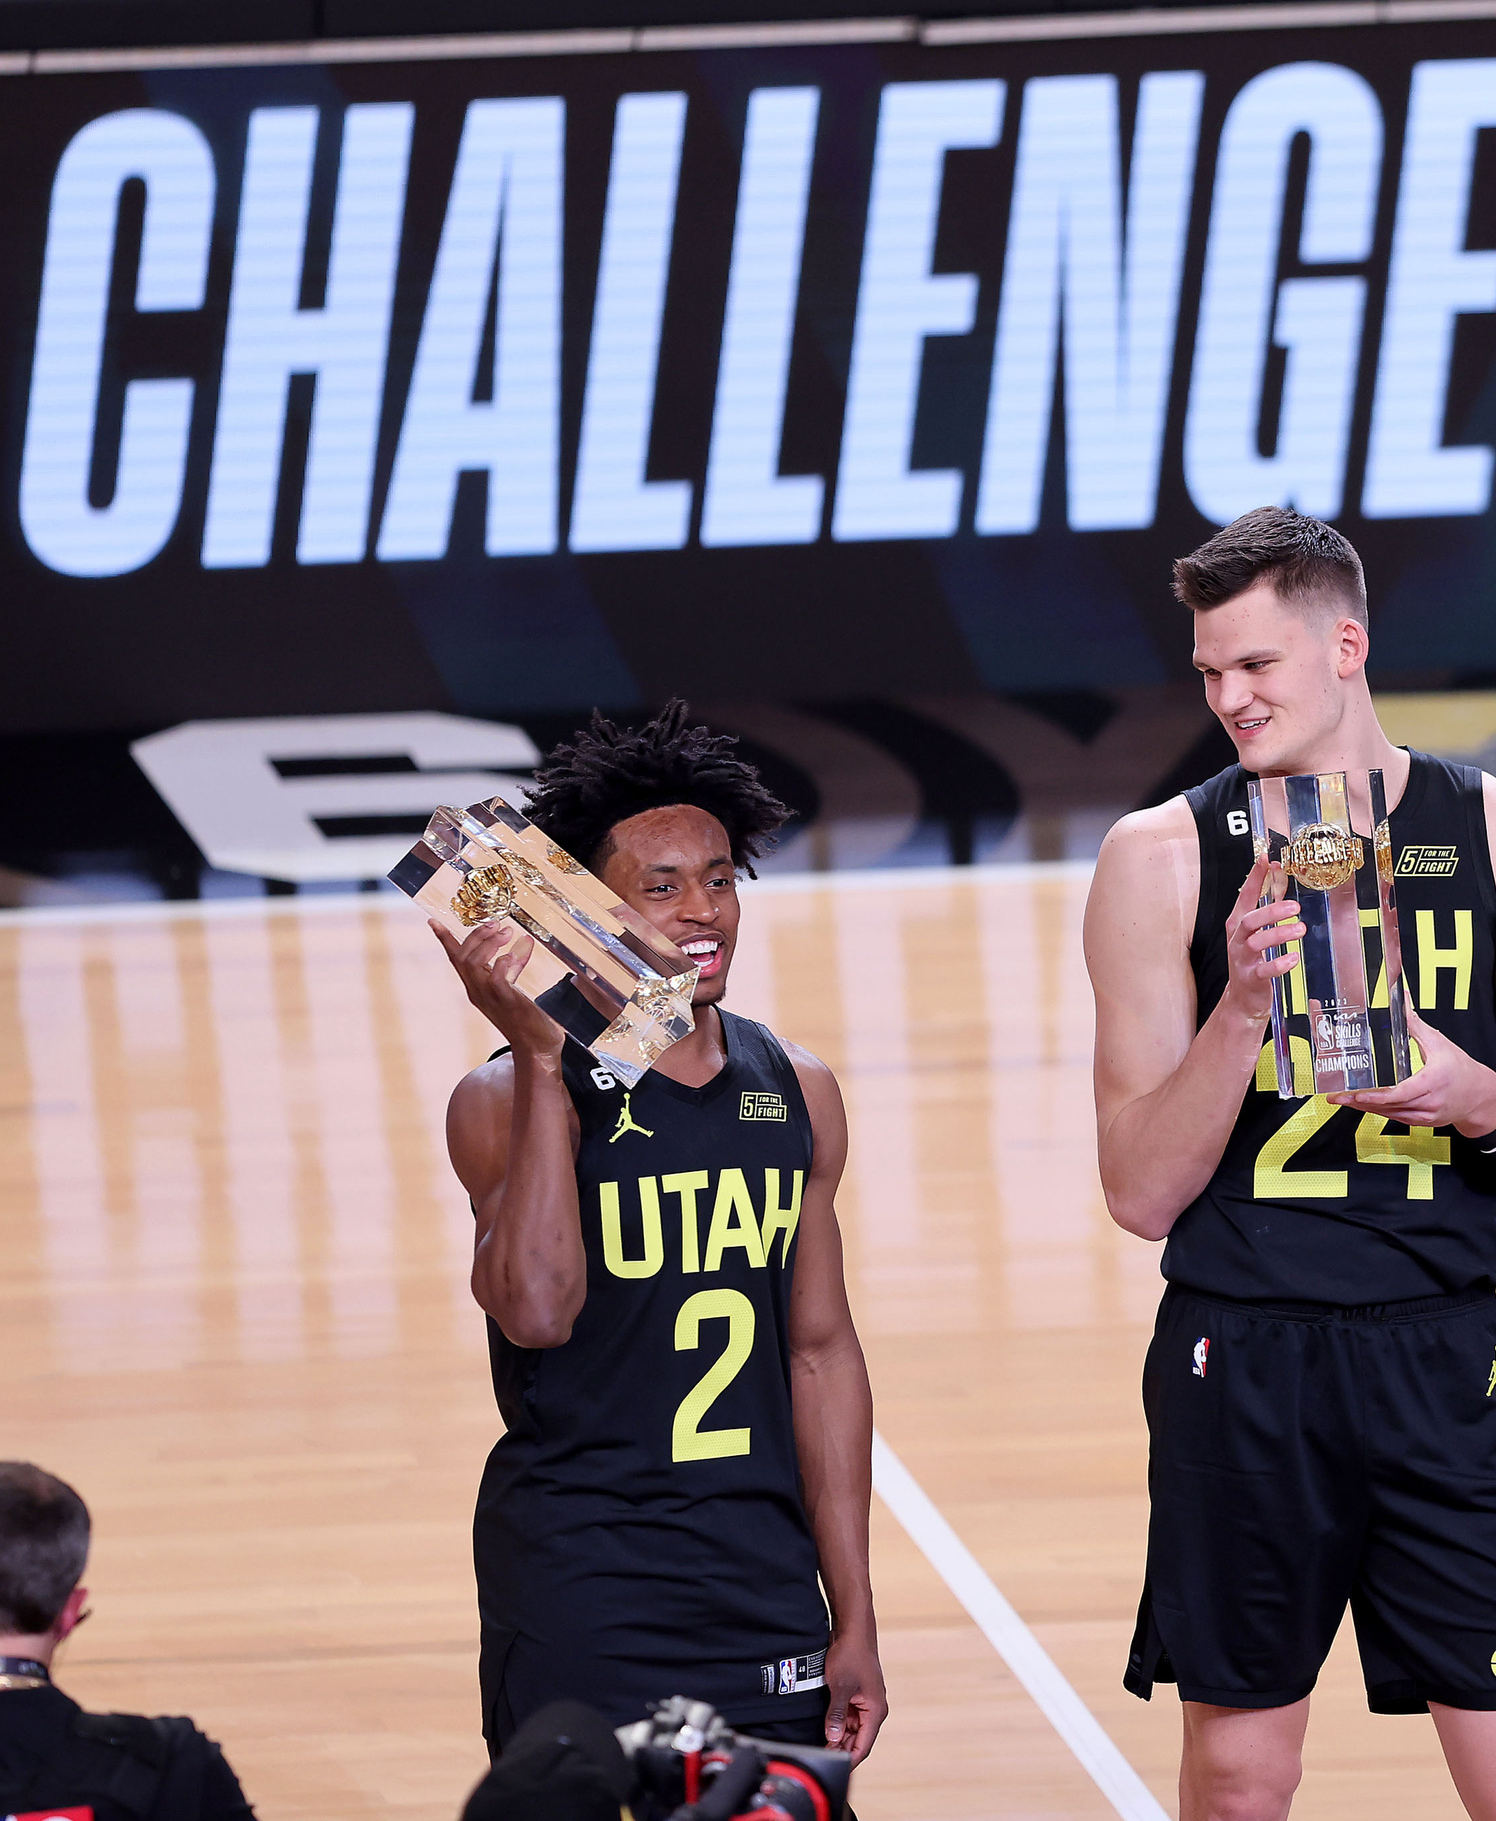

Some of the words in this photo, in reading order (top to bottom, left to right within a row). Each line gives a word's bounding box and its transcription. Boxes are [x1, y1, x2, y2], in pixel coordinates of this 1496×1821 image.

[1226, 810, 1250, 836] 6
[1400, 849, 1418, 874] 5
[1423, 849, 1438, 858] FOR
[1438, 849, 1451, 858] THE
[1418, 861, 1454, 873] FIGHT
[1335, 1023, 1361, 1040] SKILLS
[1316, 1055, 1369, 1073] CHAMPIONS
[589, 1067, 616, 1091] 6
[743, 1095, 755, 1118] 5
[758, 1096, 770, 1104] FOR
[770, 1097, 779, 1105] THE
[757, 1106, 784, 1119] FIGHT
[1254, 1034, 1451, 1200] 24
[599, 1168, 804, 1279] UTAH
[672, 1288, 756, 1463] 2
